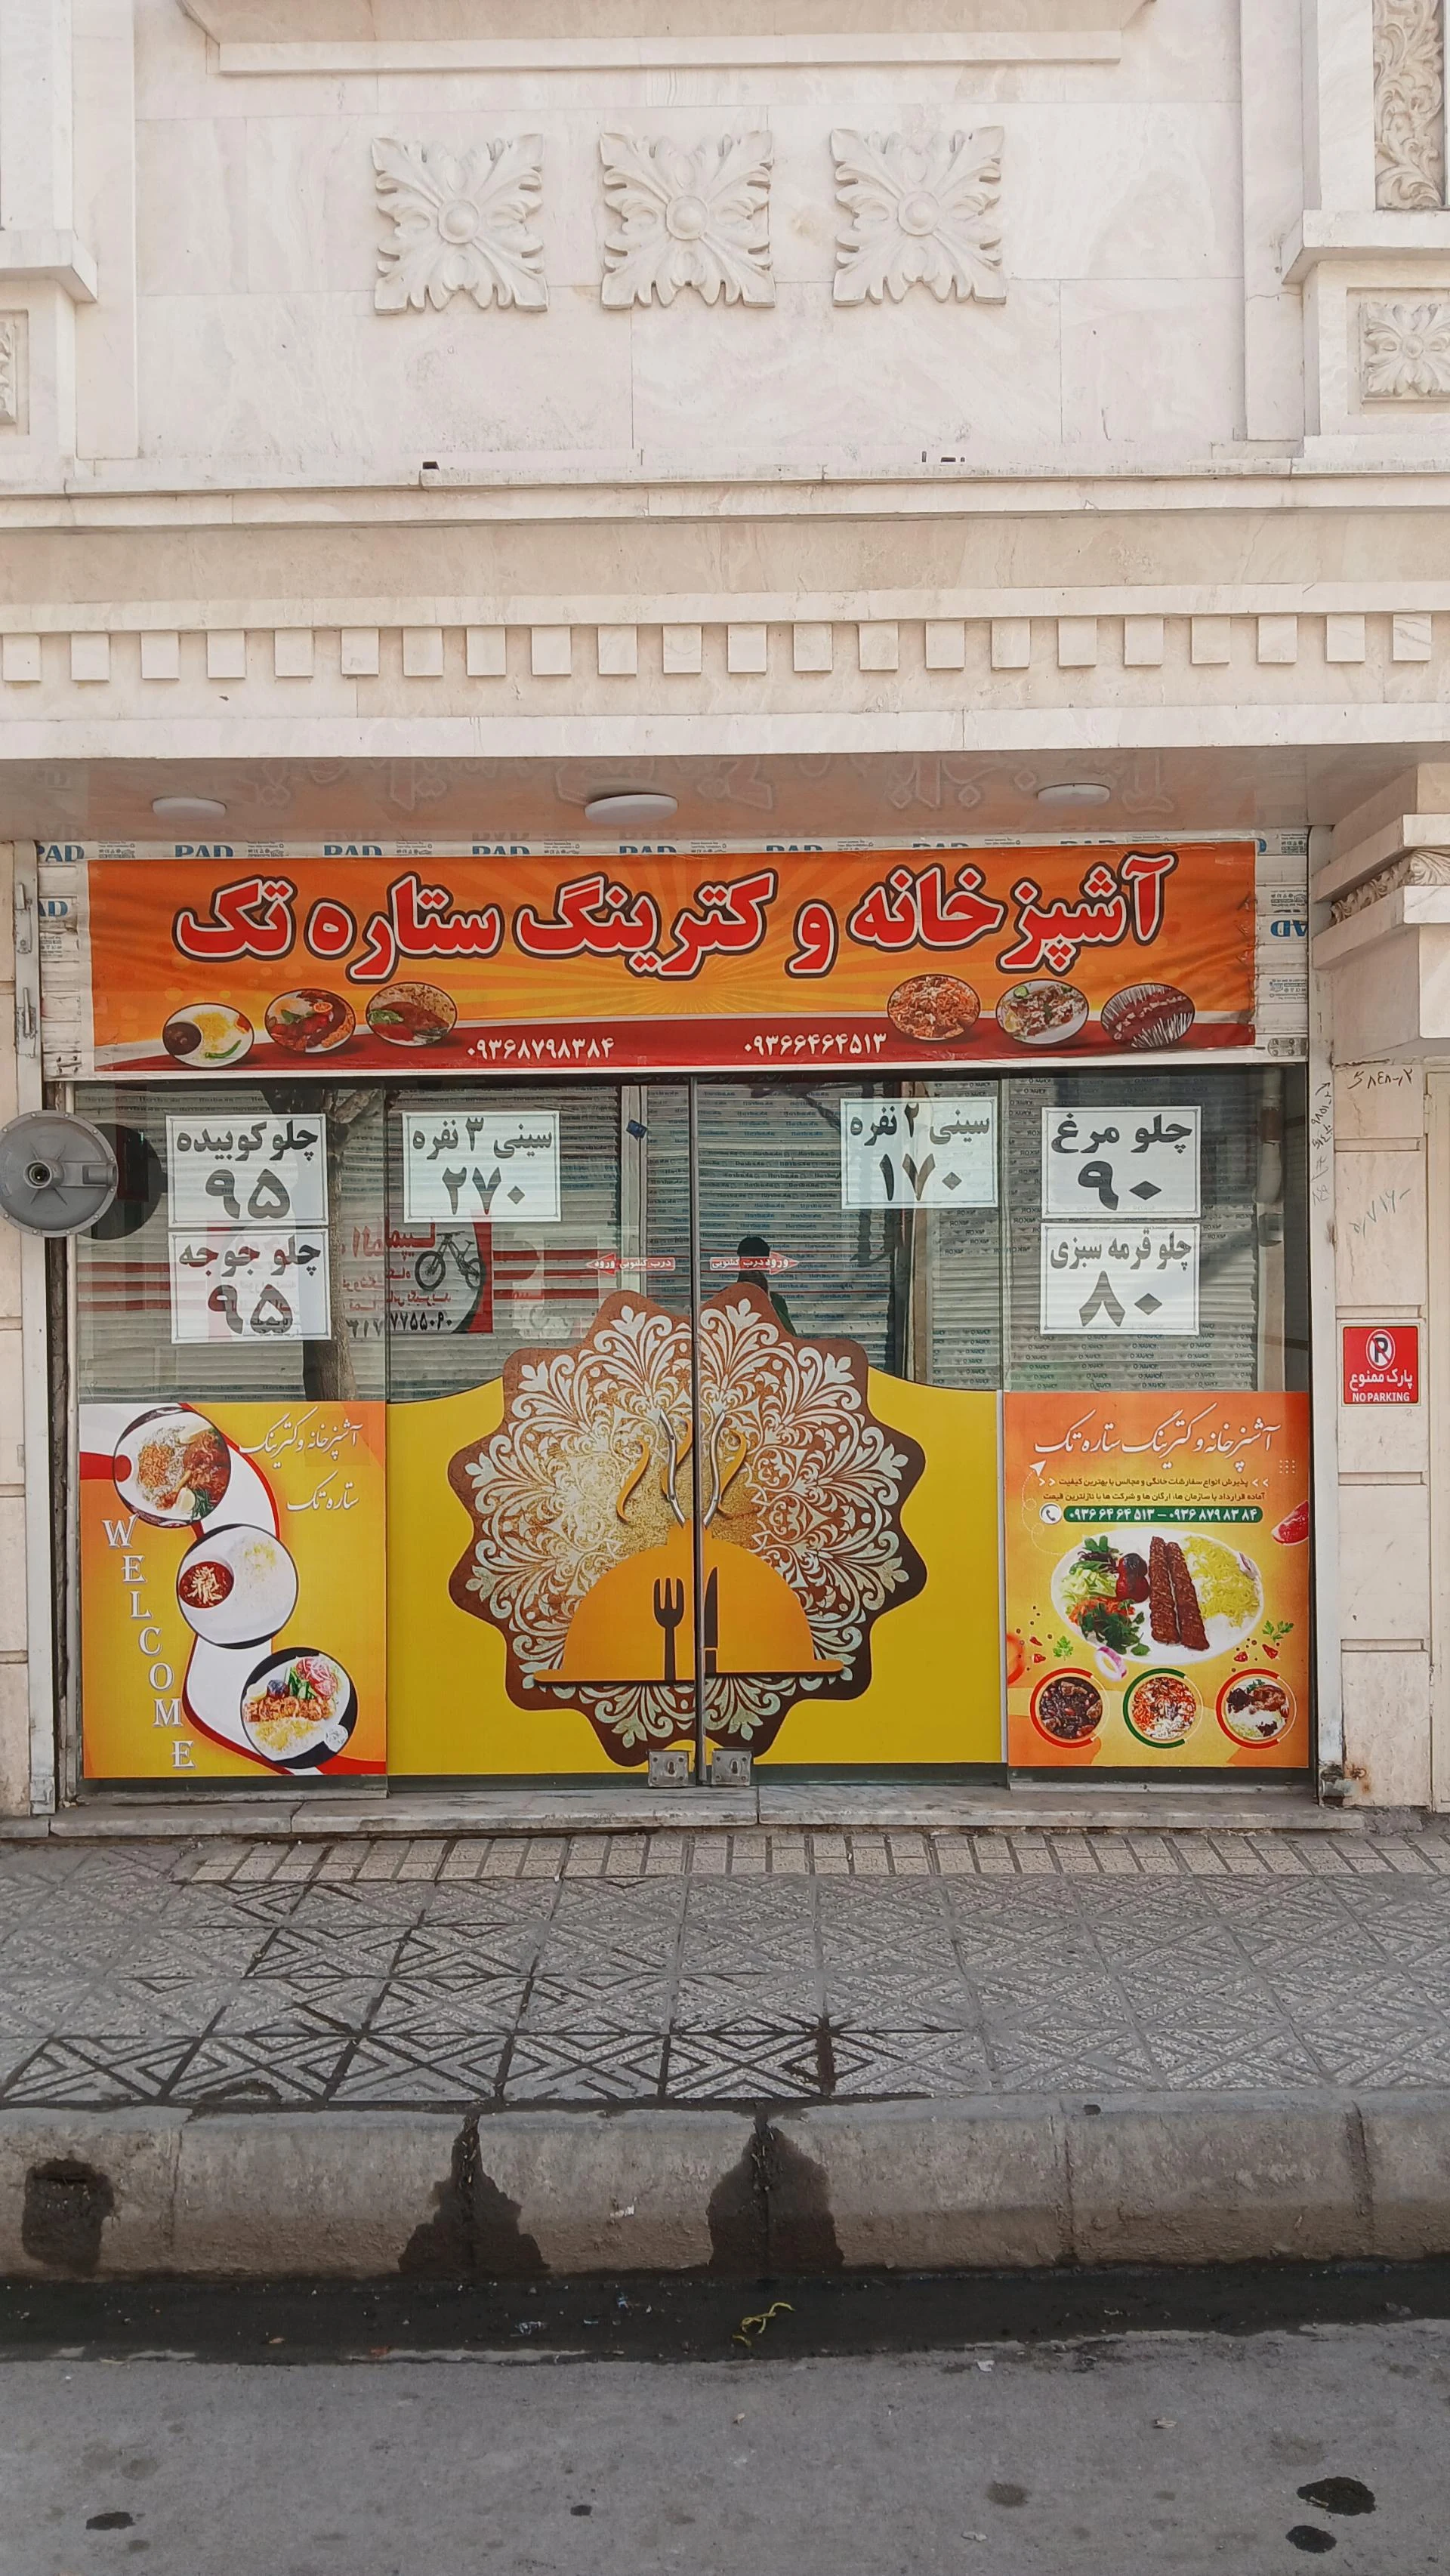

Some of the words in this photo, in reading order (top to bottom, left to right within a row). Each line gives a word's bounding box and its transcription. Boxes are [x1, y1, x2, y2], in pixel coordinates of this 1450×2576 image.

[173, 874, 296, 960] تک
[307, 872, 501, 983] ستاره
[514, 868, 777, 980] کترینگ
[787, 898, 838, 977] و
[467, 1037, 614, 1060] ۰۹۳۶۸۷۹۸۳۸۴
[744, 1033, 887, 1056] ۰۹۳۶۶۴۶۴۵۱۳
[465, 1117, 484, 1151] ۳
[850, 1106, 897, 1146] نفره
[904, 1102, 919, 1138] ۲
[930, 1109, 990, 1145] سینی
[1051, 1112, 1120, 1154] مرغ
[1131, 1114, 1192, 1154] چلو
[176, 1120, 267, 1161] کوبیده
[270, 1119, 318, 1161] چلو
[412, 1119, 459, 1160] نفره
[494, 1123, 552, 1159] سینی
[205, 1169, 292, 1219] ۹۵
[442, 1166, 526, 1216] ۲۷۰
[879, 1153, 962, 1201] ۱۷۰
[1078, 1160, 1162, 1210] ۹۰
[270, 1234, 321, 1277] چلو
[1050, 1237, 1102, 1270] سبزی
[1108, 1228, 1152, 1270] قرمه
[1157, 1231, 1192, 1271] چلو
[208, 1283, 293, 1334] ۹۵
[1079, 1270, 1163, 1327] ۸۰
[1350, 1370, 1384, 1391] ممنوع
[1353, 1392, 1365, 1402] NO
[1367, 1391, 1410, 1402] PARKING
[1387, 1368, 1413, 1389] پارک
[1035, 1408, 1097, 1453] تک
[1081, 1422, 1121, 1453] ستاره
[287, 1468, 339, 1511] تک
[325, 1481, 359, 1510] ستاره
[1059, 1478, 1082, 1487] کیفیت
[1084, 1478, 1108, 1487] بهترین
[1112, 1492, 1136, 1501] شرکت
[1115, 1478, 1140, 1487] مجالس
[1146, 1478, 1167, 1487] خانگی
[1152, 1492, 1171, 1501] ارگان
[1168, 1477, 1202, 1487] سفارشات
[1184, 1492, 1210, 1501] سازمان
[1203, 1478, 1220, 1488] انواع
[1218, 1493, 1245, 1501] قرارداد
[1221, 1478, 1248, 1487] پذیرش
[1247, 1492, 1265, 1500] آماده
[1069, 1508, 1096, 1521] ۰۹۳۶
[1134, 1508, 1155, 1521] ۵۱۳
[1169, 1508, 1196, 1521] ۰۹۳۶
[1199, 1508, 1220, 1521] ۸۷۹
